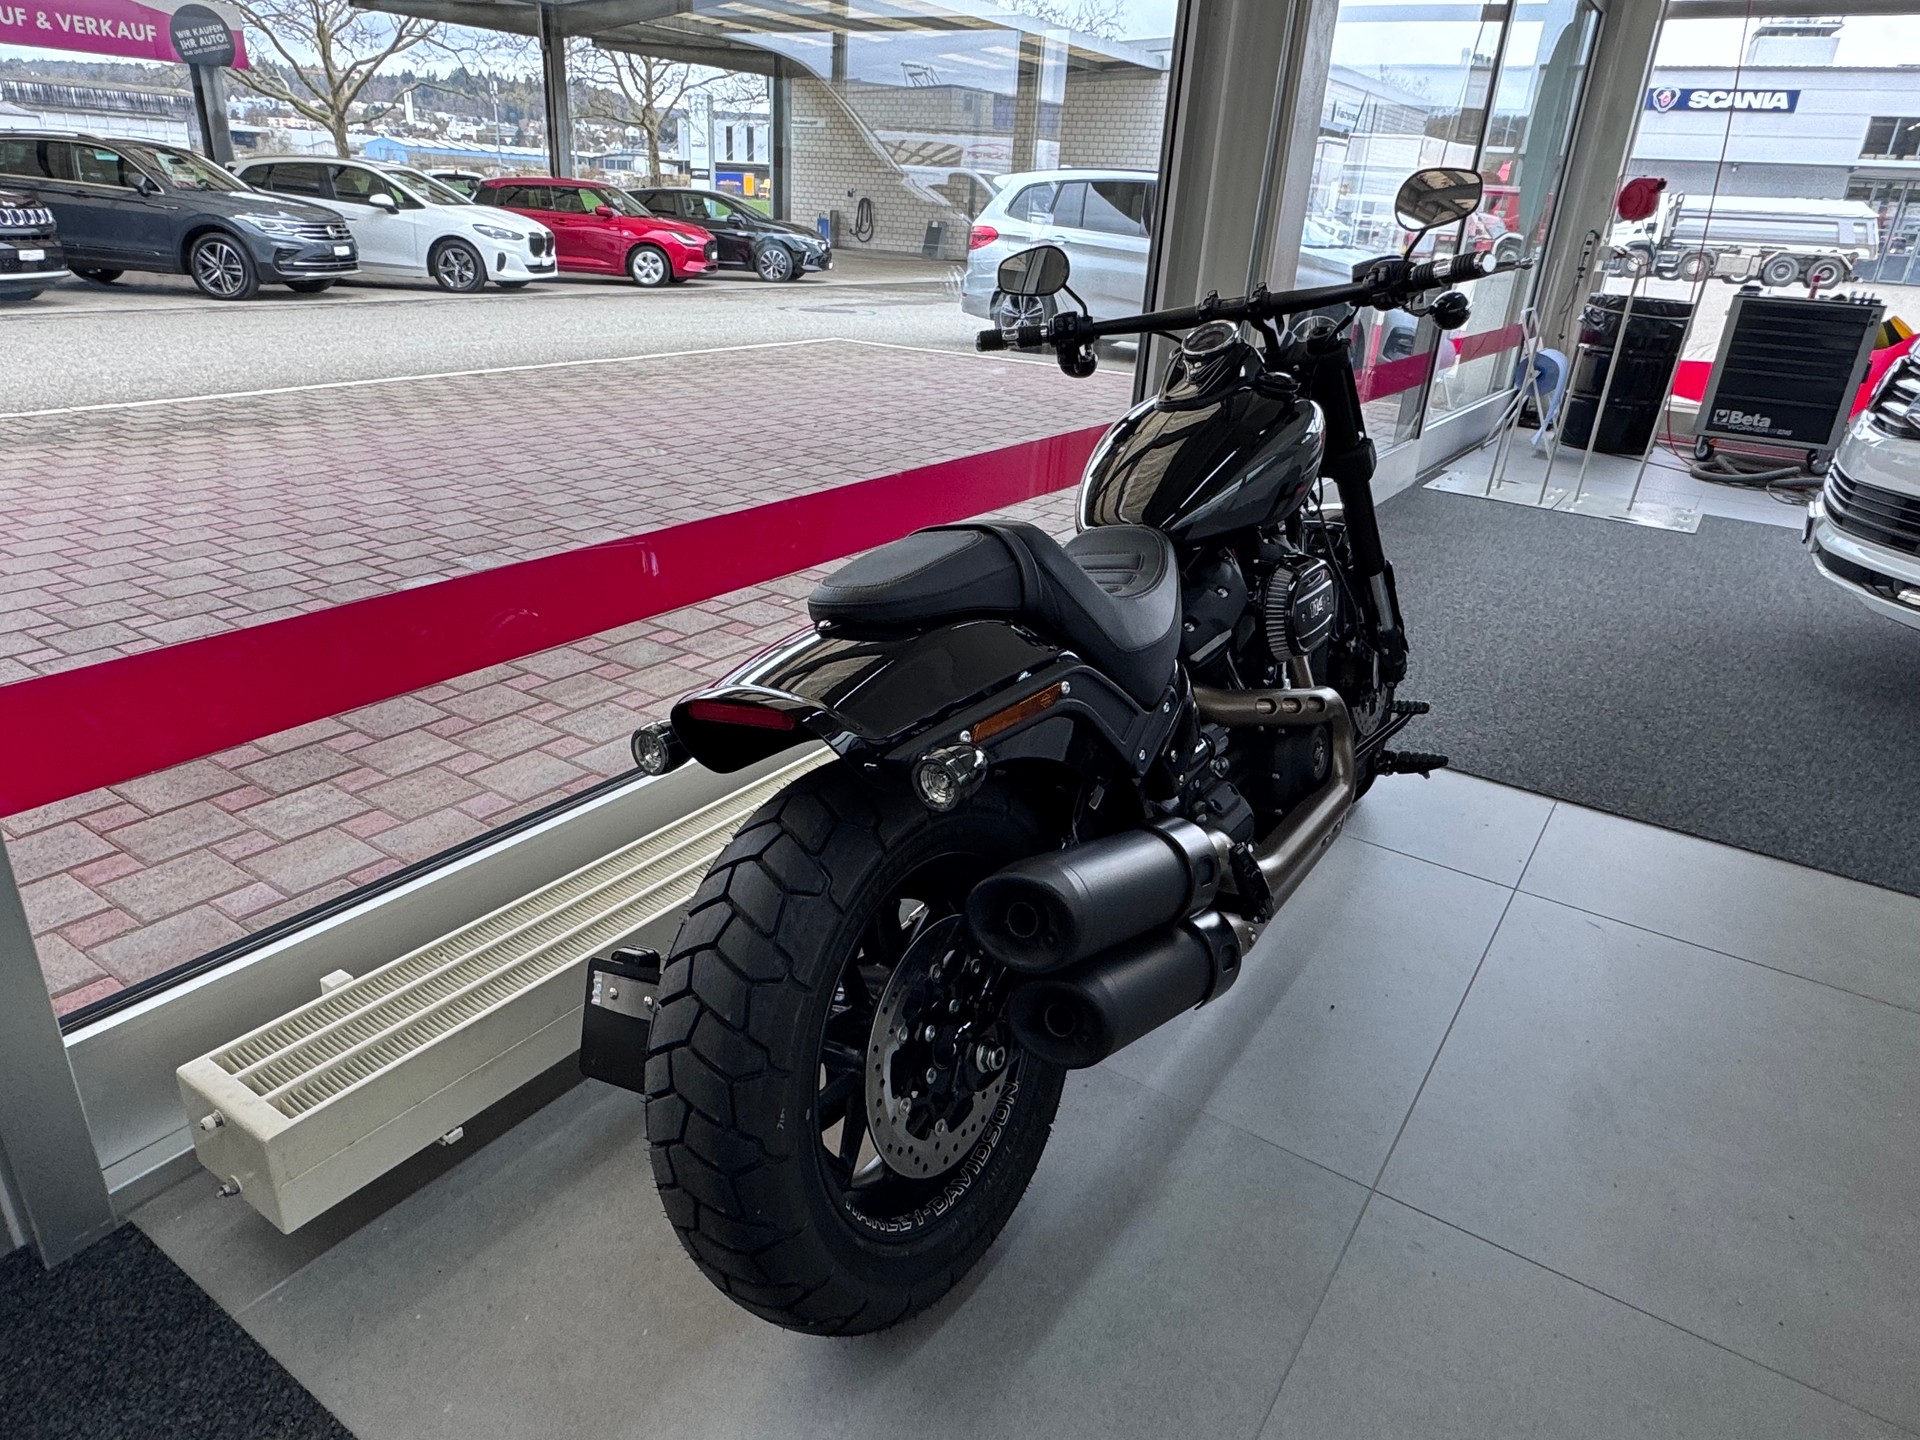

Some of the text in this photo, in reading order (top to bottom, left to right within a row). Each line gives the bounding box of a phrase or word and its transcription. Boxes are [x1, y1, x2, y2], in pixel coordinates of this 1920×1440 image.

[36, 11, 53, 30] &
[55, 12, 157, 42] VERKAUF
[175, 23, 224, 39] WIR KAUFEN
[179, 38, 198, 50] IHR
[1688, 90, 1789, 109] SCANIA
[1728, 410, 1771, 427] Beta
